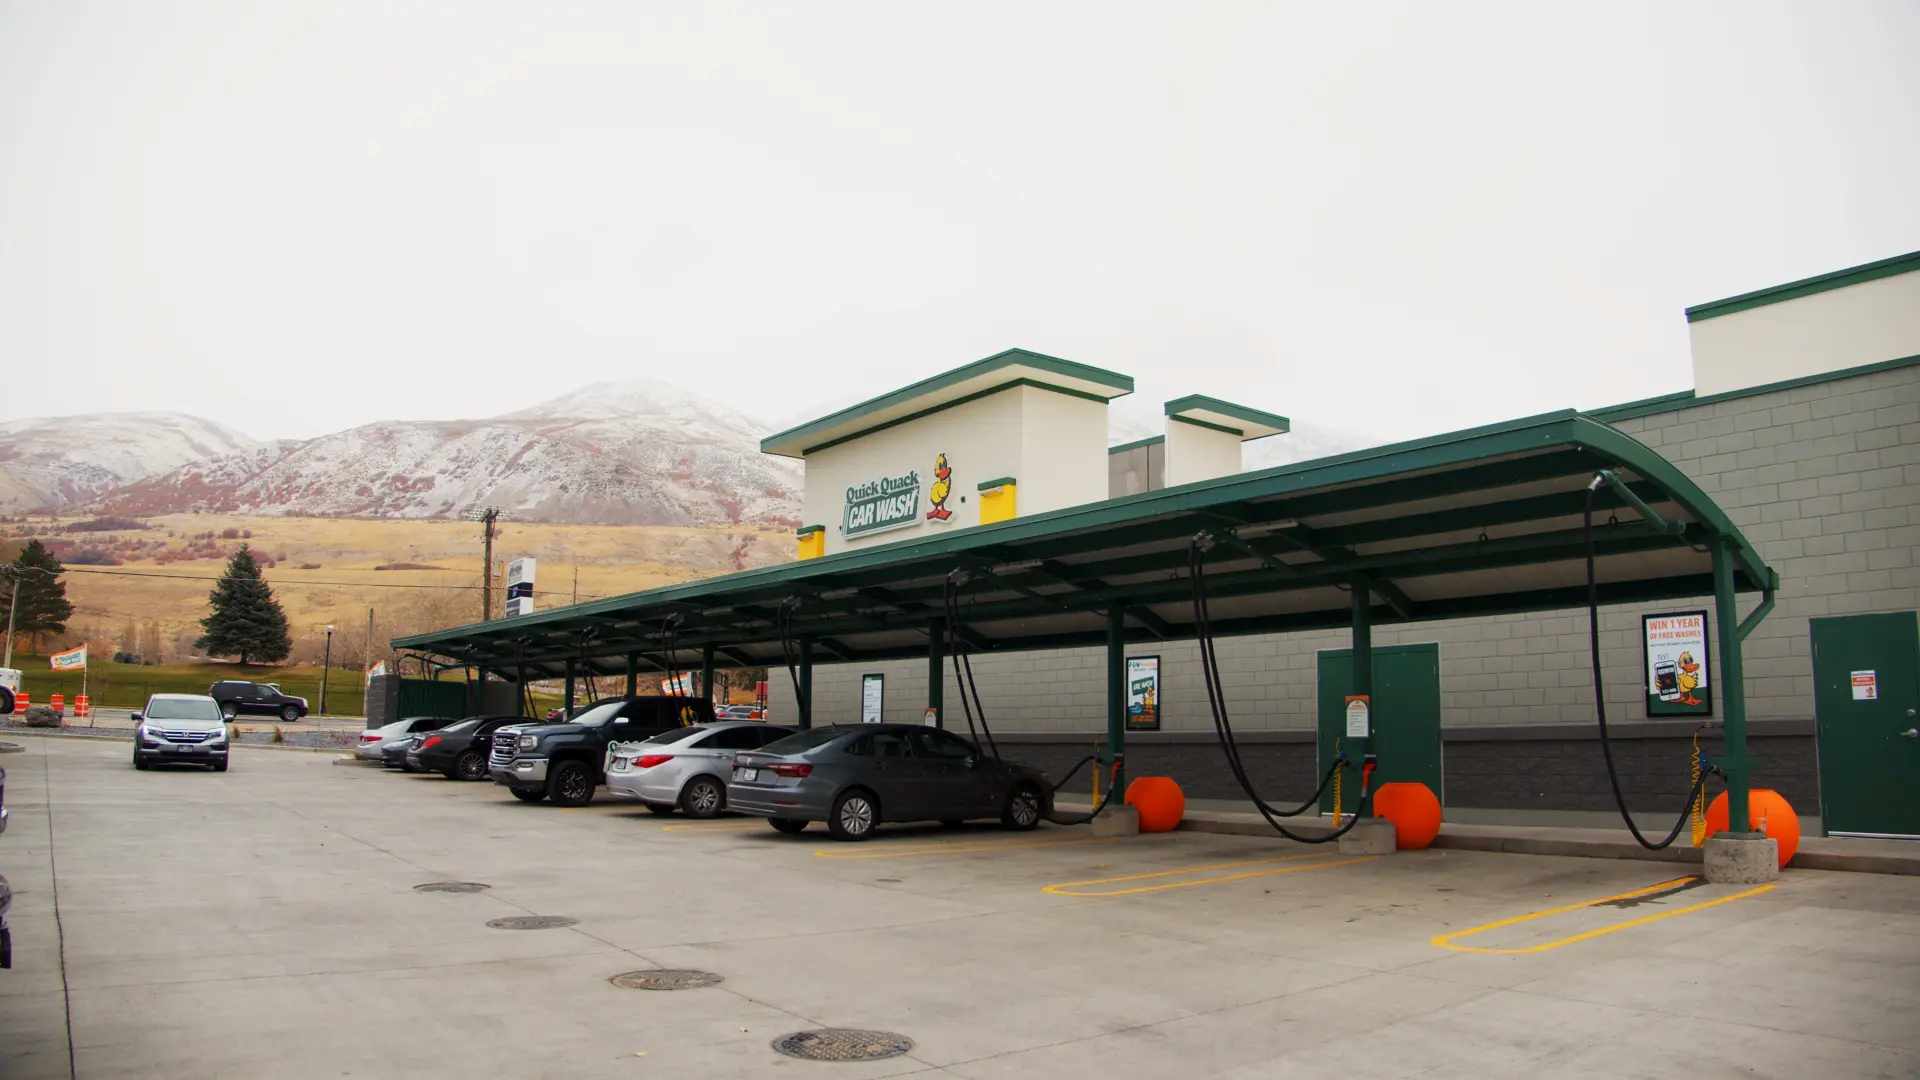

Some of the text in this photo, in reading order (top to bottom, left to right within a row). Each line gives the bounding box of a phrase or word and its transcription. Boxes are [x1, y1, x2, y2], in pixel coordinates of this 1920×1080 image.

[846, 470, 920, 505] Quick Quack
[848, 490, 918, 529] CAR WASH
[1649, 620, 1668, 630] WIN
[1677, 617, 1700, 628] YEAR
